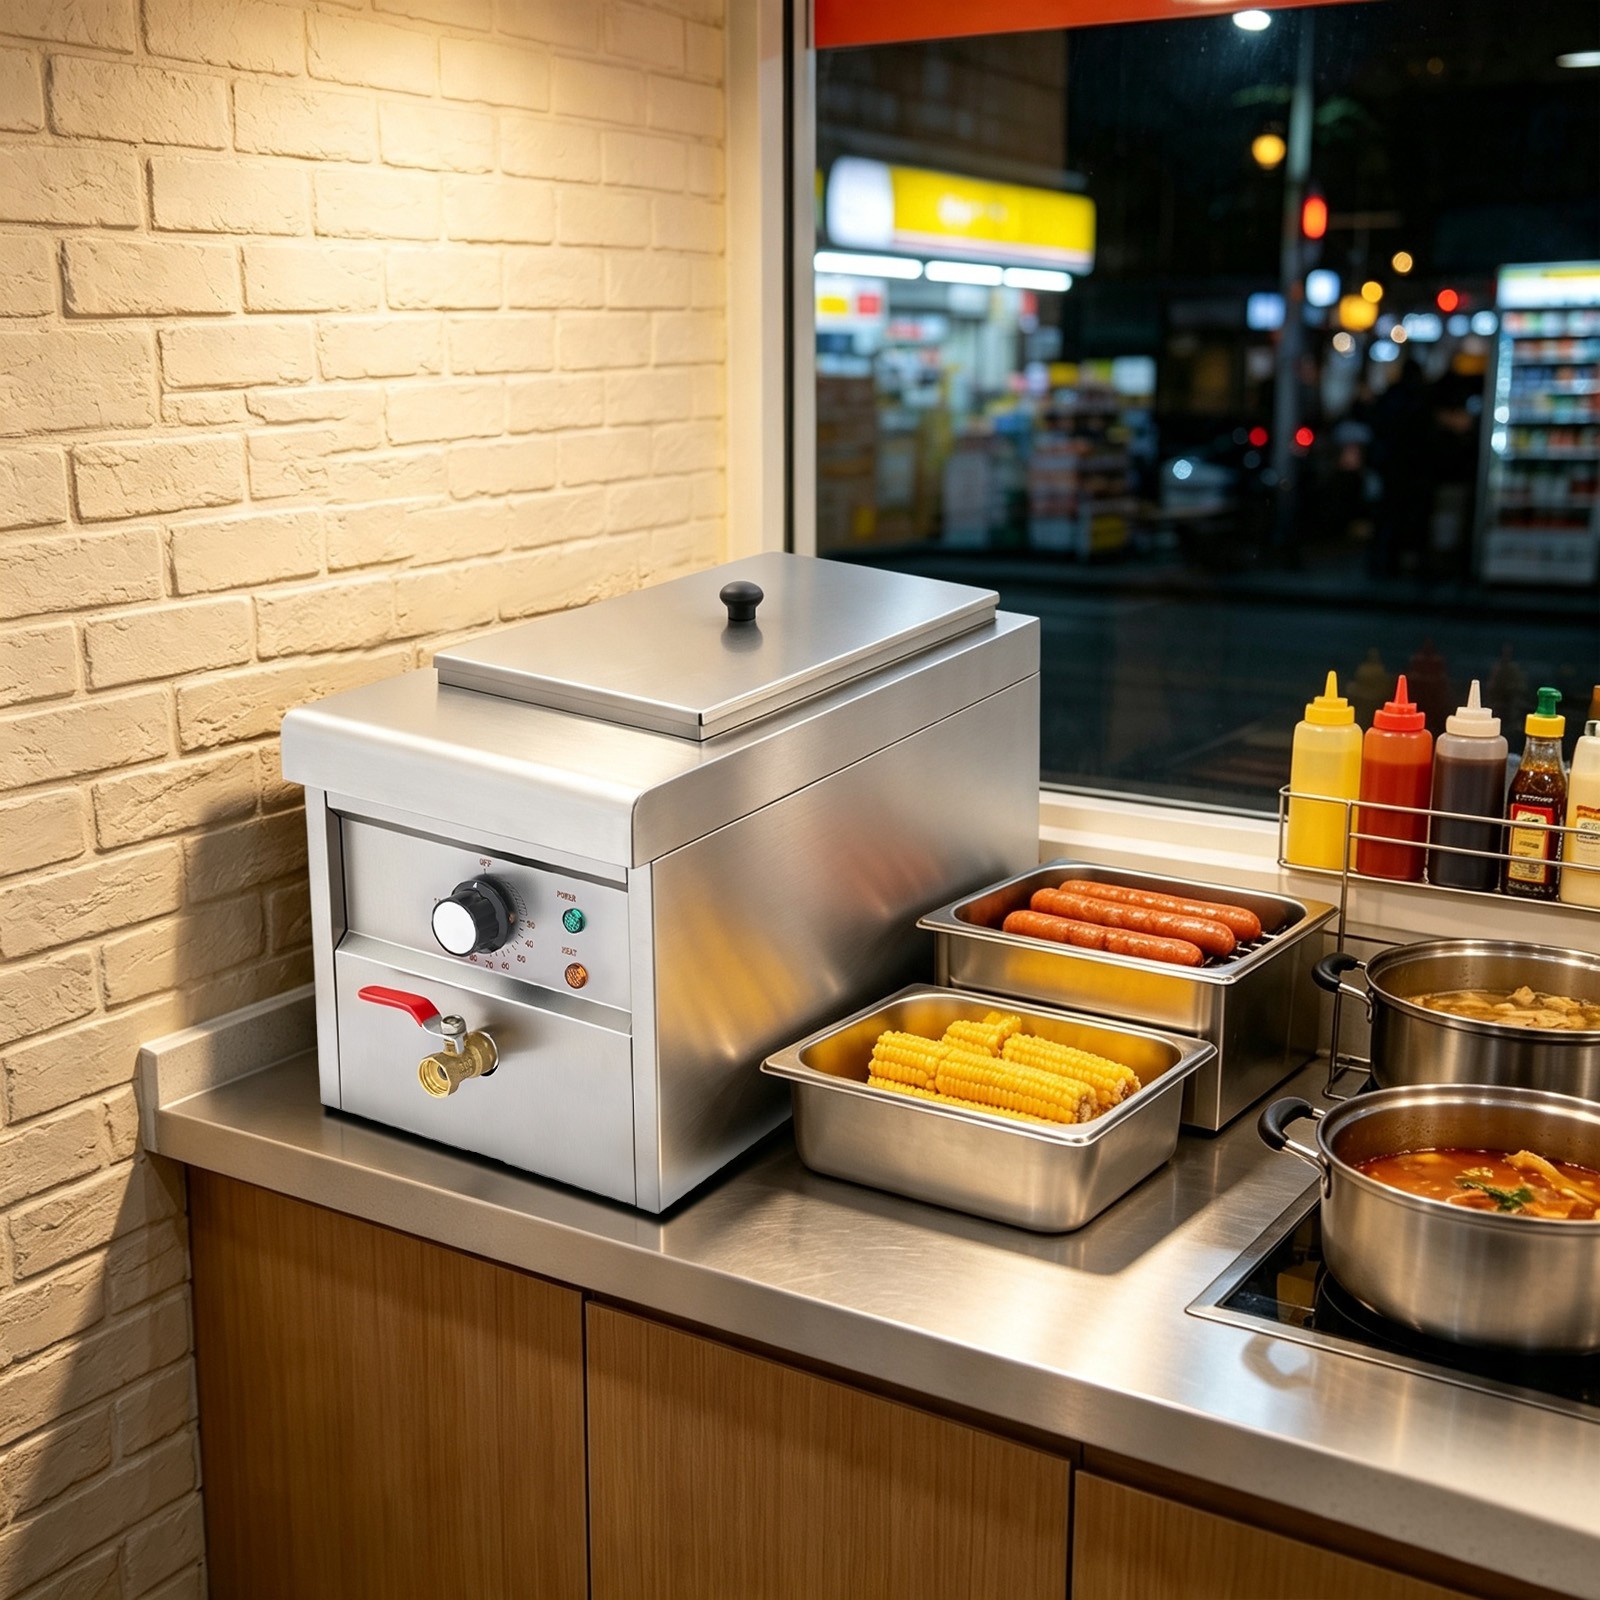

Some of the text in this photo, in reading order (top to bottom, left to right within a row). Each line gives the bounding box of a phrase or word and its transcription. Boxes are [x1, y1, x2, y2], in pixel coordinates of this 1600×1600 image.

[480, 858, 492, 867] OFF
[556, 890, 576, 902] POWER
[526, 920, 535, 929] 30
[525, 940, 534, 948] 40
[517, 954, 526, 963] 50
[485, 960, 493, 969] 70
[501, 962, 510, 970] 60
